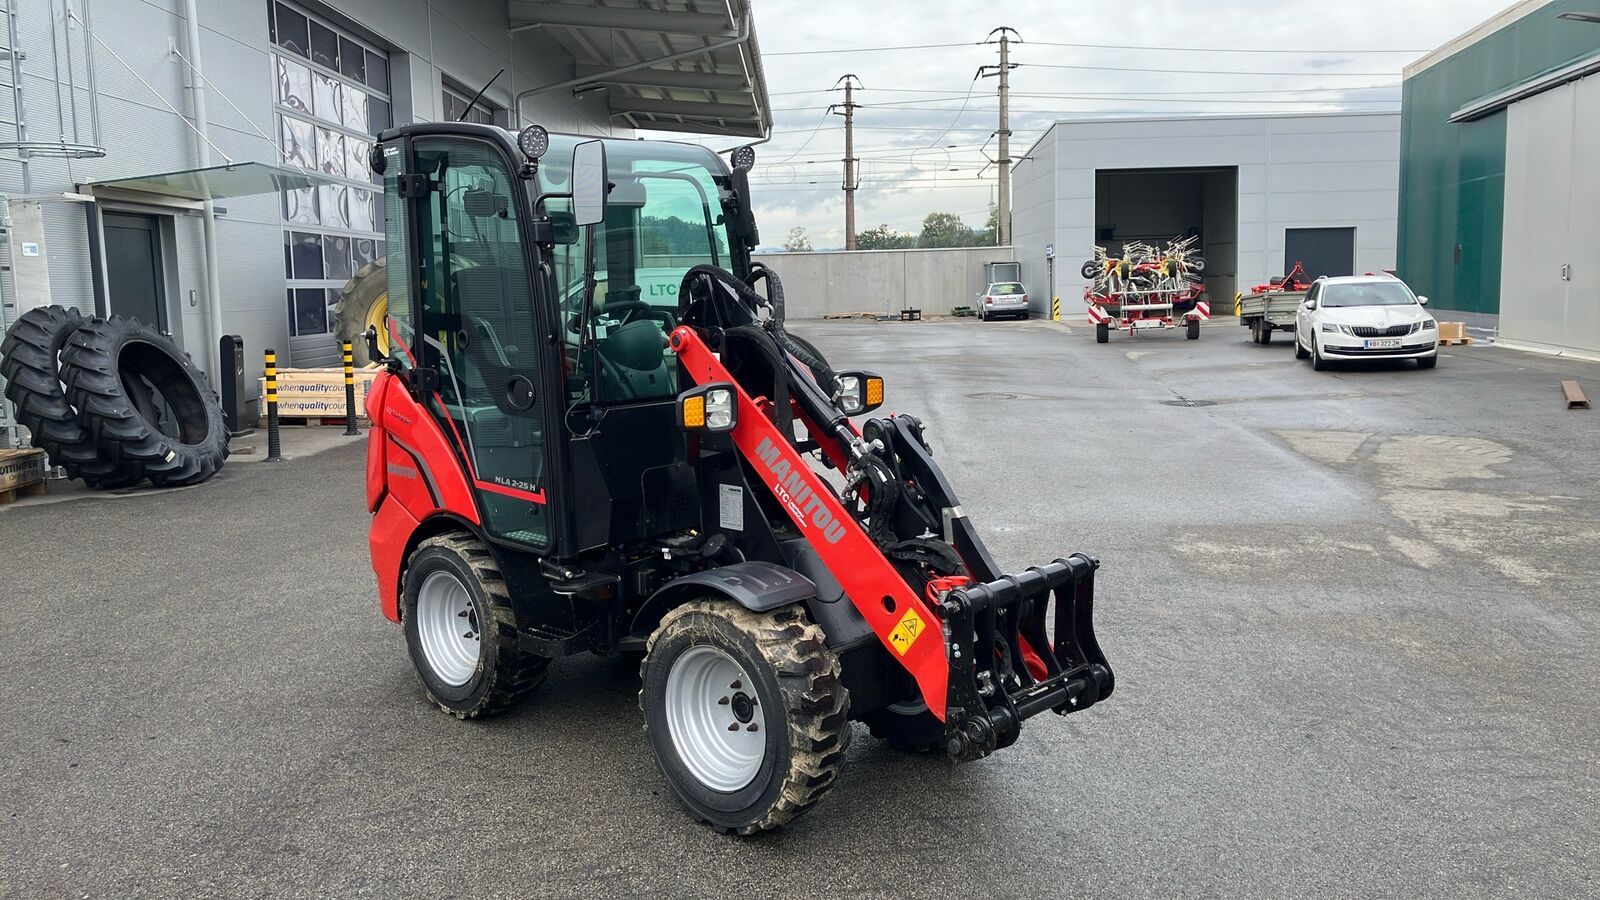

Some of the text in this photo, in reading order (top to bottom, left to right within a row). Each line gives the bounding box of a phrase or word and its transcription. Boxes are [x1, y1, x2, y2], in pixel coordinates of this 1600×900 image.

[650, 284, 677, 296] LTC
[495, 475, 511, 486] MLA
[529, 483, 536, 491] H
[754, 436, 847, 544] MANITOU
[774, 483, 790, 503] LTC
